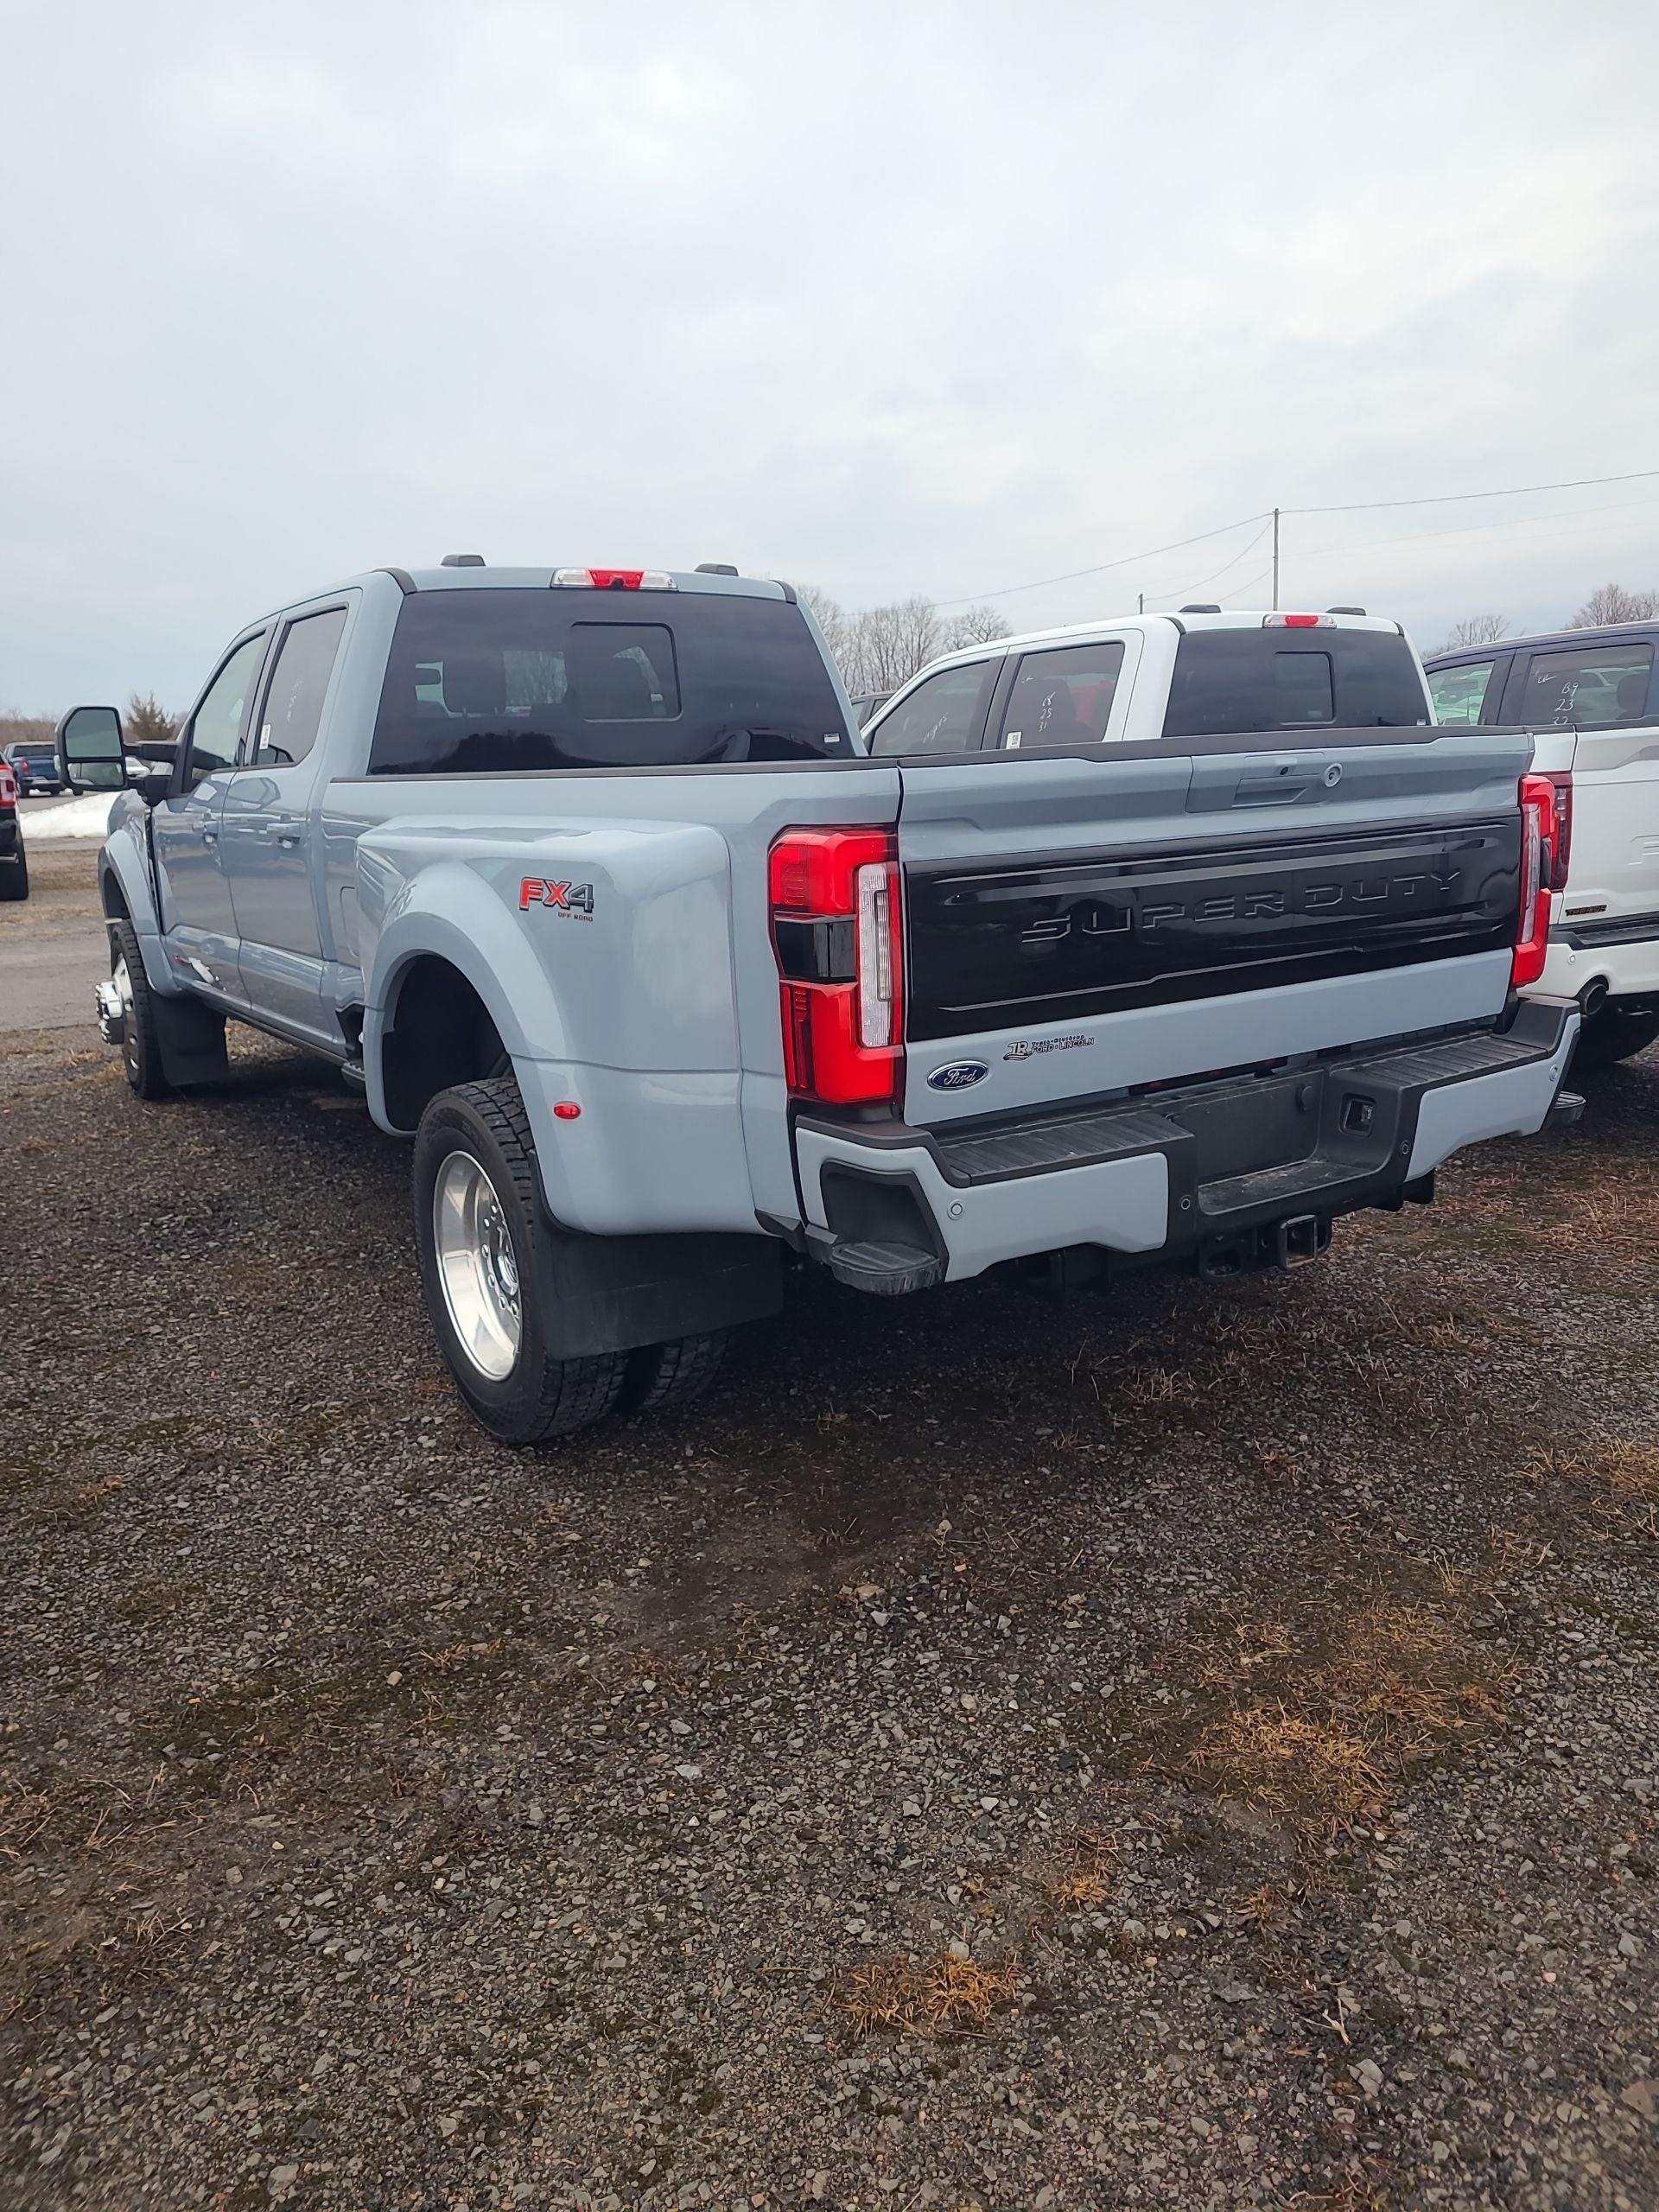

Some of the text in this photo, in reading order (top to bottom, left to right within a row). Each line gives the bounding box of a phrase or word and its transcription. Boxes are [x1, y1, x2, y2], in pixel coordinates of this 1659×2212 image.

[1554, 698, 1574, 712] 23
[519, 876, 594, 913] FX4
[1020, 870, 1462, 944] SUPER DUTY
[1032, 1043, 1055, 1054] FORD
[1059, 1037, 1095, 1051] LINCOLN
[943, 1067, 977, 1086] Ford
